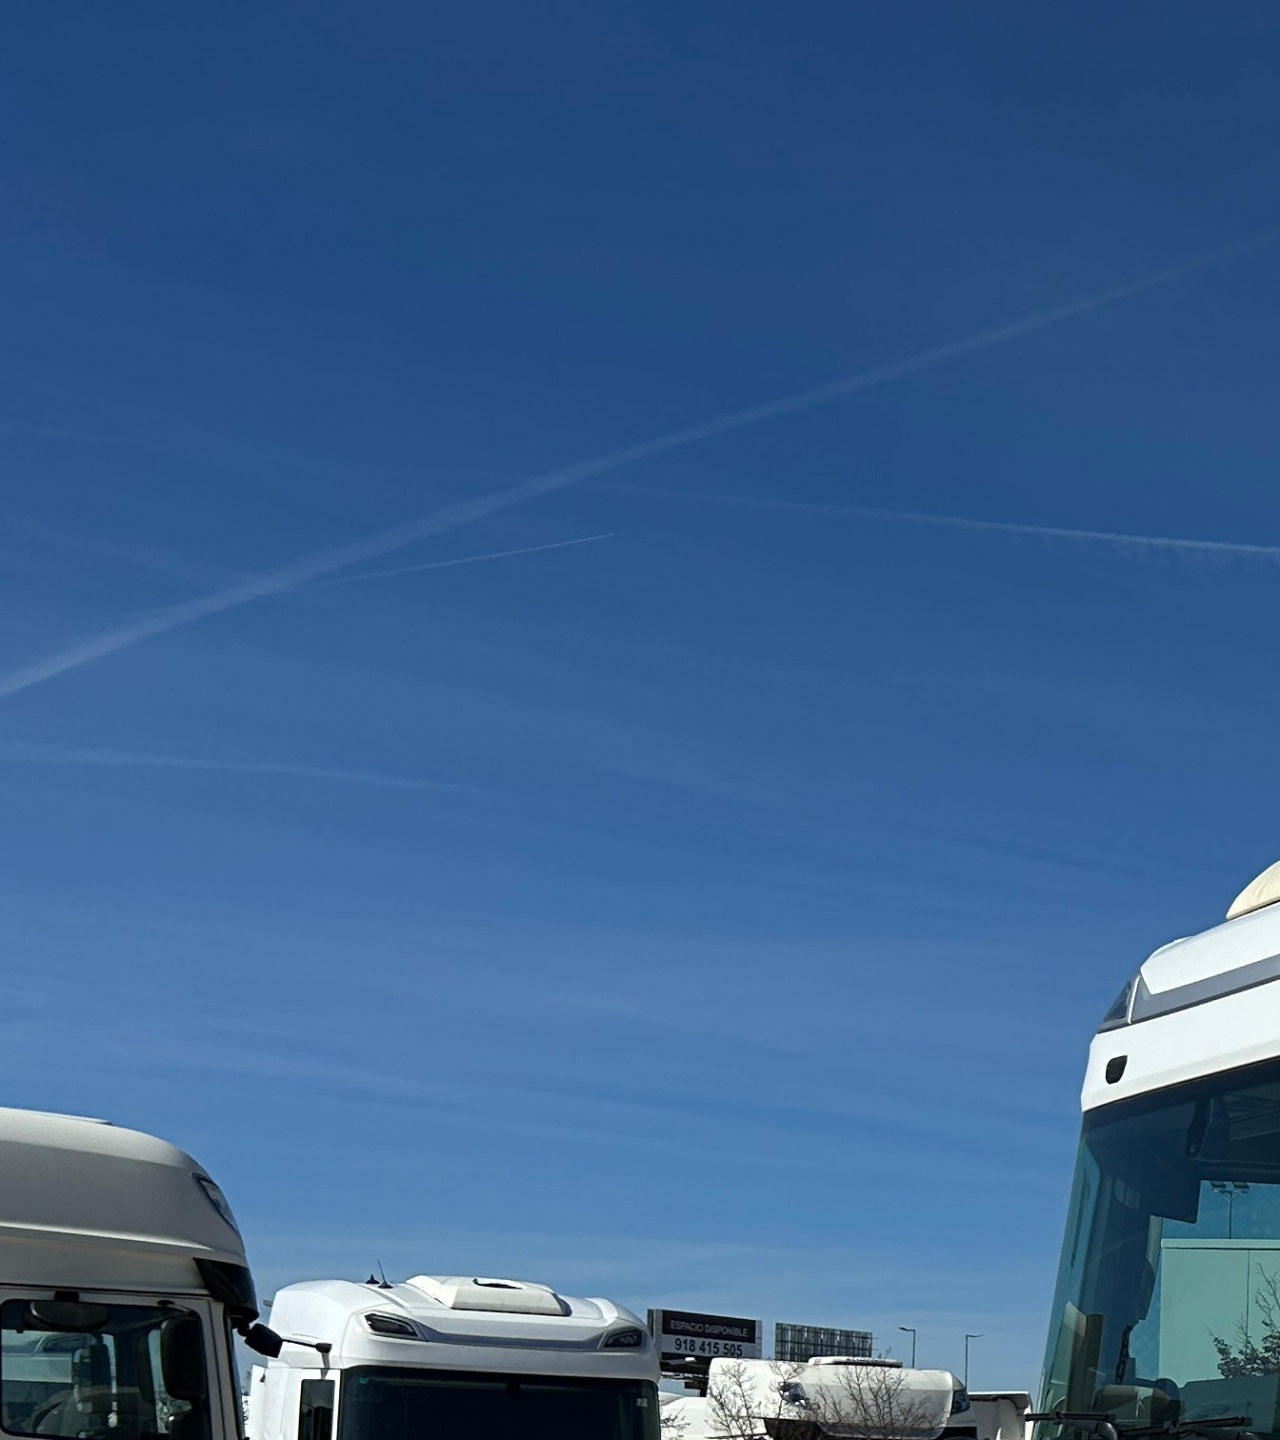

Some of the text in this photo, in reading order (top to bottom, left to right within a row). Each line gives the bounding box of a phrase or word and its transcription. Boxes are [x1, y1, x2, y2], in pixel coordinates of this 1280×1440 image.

[670, 1320, 749, 1338] ESPACIO DISPONIBLE
[674, 1338, 743, 1357] 918 415 505
